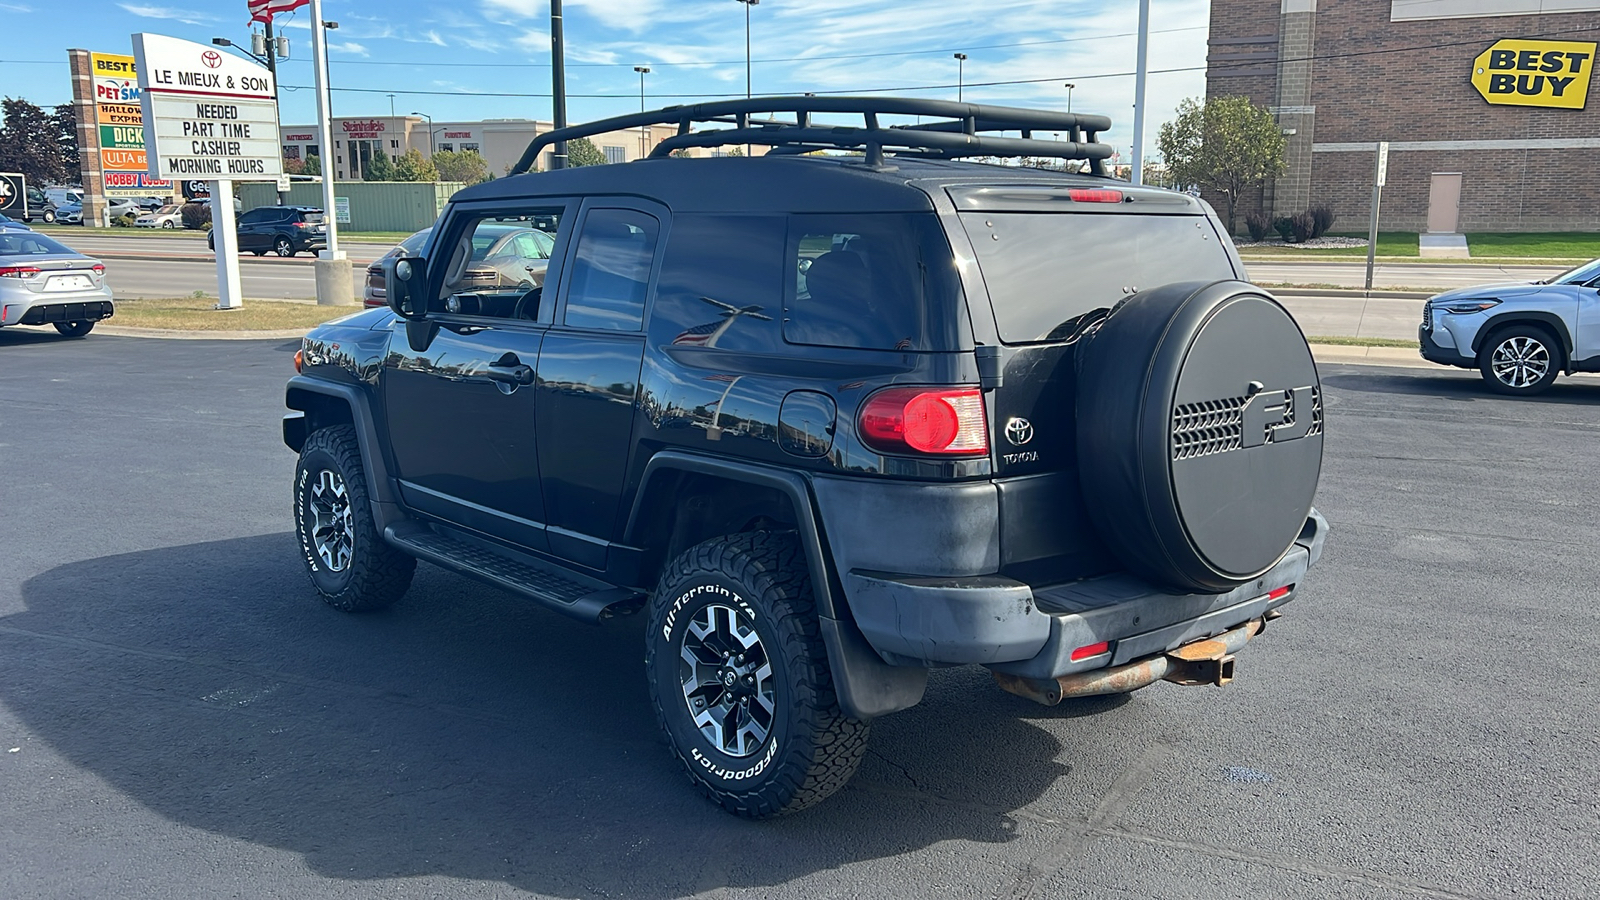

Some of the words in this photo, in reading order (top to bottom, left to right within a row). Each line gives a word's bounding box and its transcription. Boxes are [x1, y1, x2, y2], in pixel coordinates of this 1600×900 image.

[97, 60, 128, 72] BEST
[1489, 50, 1590, 73] BEST
[155, 69, 173, 84] LE
[178, 71, 220, 88] MIEUX
[226, 75, 236, 89] &
[241, 76, 269, 92] SON
[1489, 74, 1576, 97] BUY
[197, 104, 238, 119] NEEDED
[183, 121, 214, 137] PART
[221, 123, 251, 138] TIME
[192, 140, 241, 156] CASHIER
[107, 152, 135, 164] ULTA
[169, 158, 221, 174] MORNING
[228, 159, 264, 173] HOURS
[105, 173, 138, 186] HOBBY
[1241, 386, 1313, 449] FJ
[1003, 451, 1040, 465] TOYOTA
[298, 491, 318, 572] All-Terrain
[663, 584, 730, 642] All-Terrain
[732, 592, 756, 620] T/A
[691, 736, 778, 780] BFGoodrich
